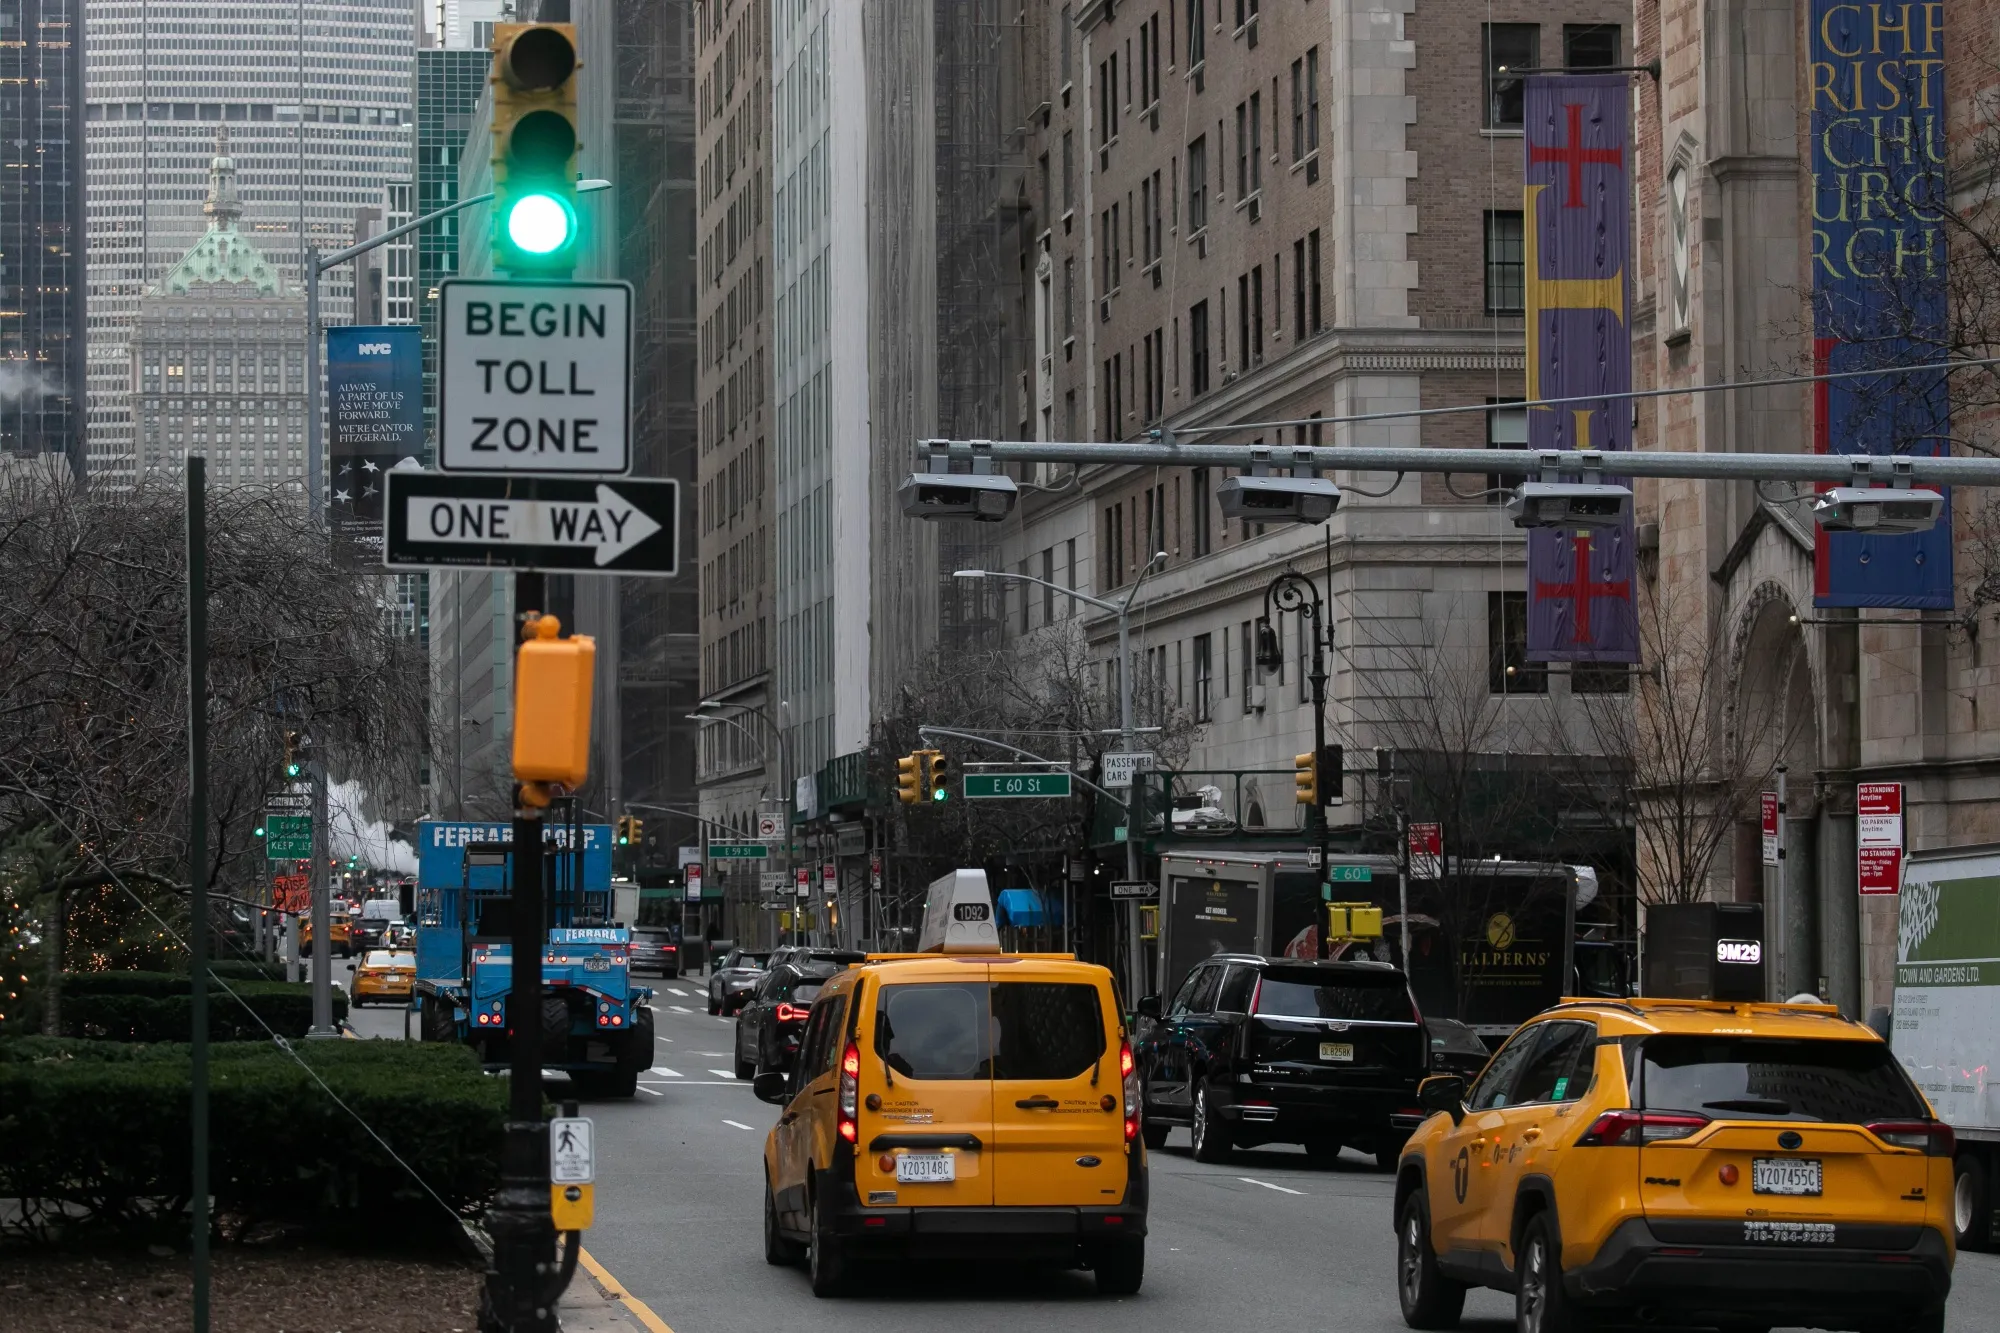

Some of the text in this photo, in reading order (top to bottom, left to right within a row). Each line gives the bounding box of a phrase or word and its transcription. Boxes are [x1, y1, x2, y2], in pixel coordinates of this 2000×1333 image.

[1811, 60, 1943, 112] RIST
[466, 301, 606, 338] BEGIN
[359, 343, 391, 355] NYC
[475, 359, 595, 396] TOLL
[338, 383, 376, 392] ALWAYS
[339, 391, 404, 401] A PART OF US
[339, 400, 401, 411] AS WE MOVE
[338, 411, 391, 420] FORWARD.
[338, 423, 414, 433] WE'RE CANTOR
[339, 433, 402, 443] FITZGERALD.
[471, 417, 599, 453] ZONE
[430, 503, 632, 543] ONE WAY
[1106, 757, 1152, 768] PASSENER
[1106, 771, 1127, 781] CARS
[994, 778, 1041, 792] E 60 St
[1861, 794, 1882, 802] Anytime
[434, 826, 514, 847] FERRAR
[1862, 826, 1883, 834] Anytime
[732, 847, 741, 855] 59
[743, 847, 751, 855] St
[1331, 868, 1338, 877] E
[1344, 867, 1361, 880] 60
[1118, 886, 1154, 894] ONE WAY
[959, 906, 983, 920] 1D92
[565, 928, 617, 942] FERRARA
[1717, 943, 1760, 961] 9M29
[1898, 966, 1980, 984] TOWN AND GARDENS LTD.
[902, 1161, 949, 1175] Y203148C
[1760, 1168, 1815, 1186] Y207455C
[1744, 1230, 1836, 1243] 718-784-9292
